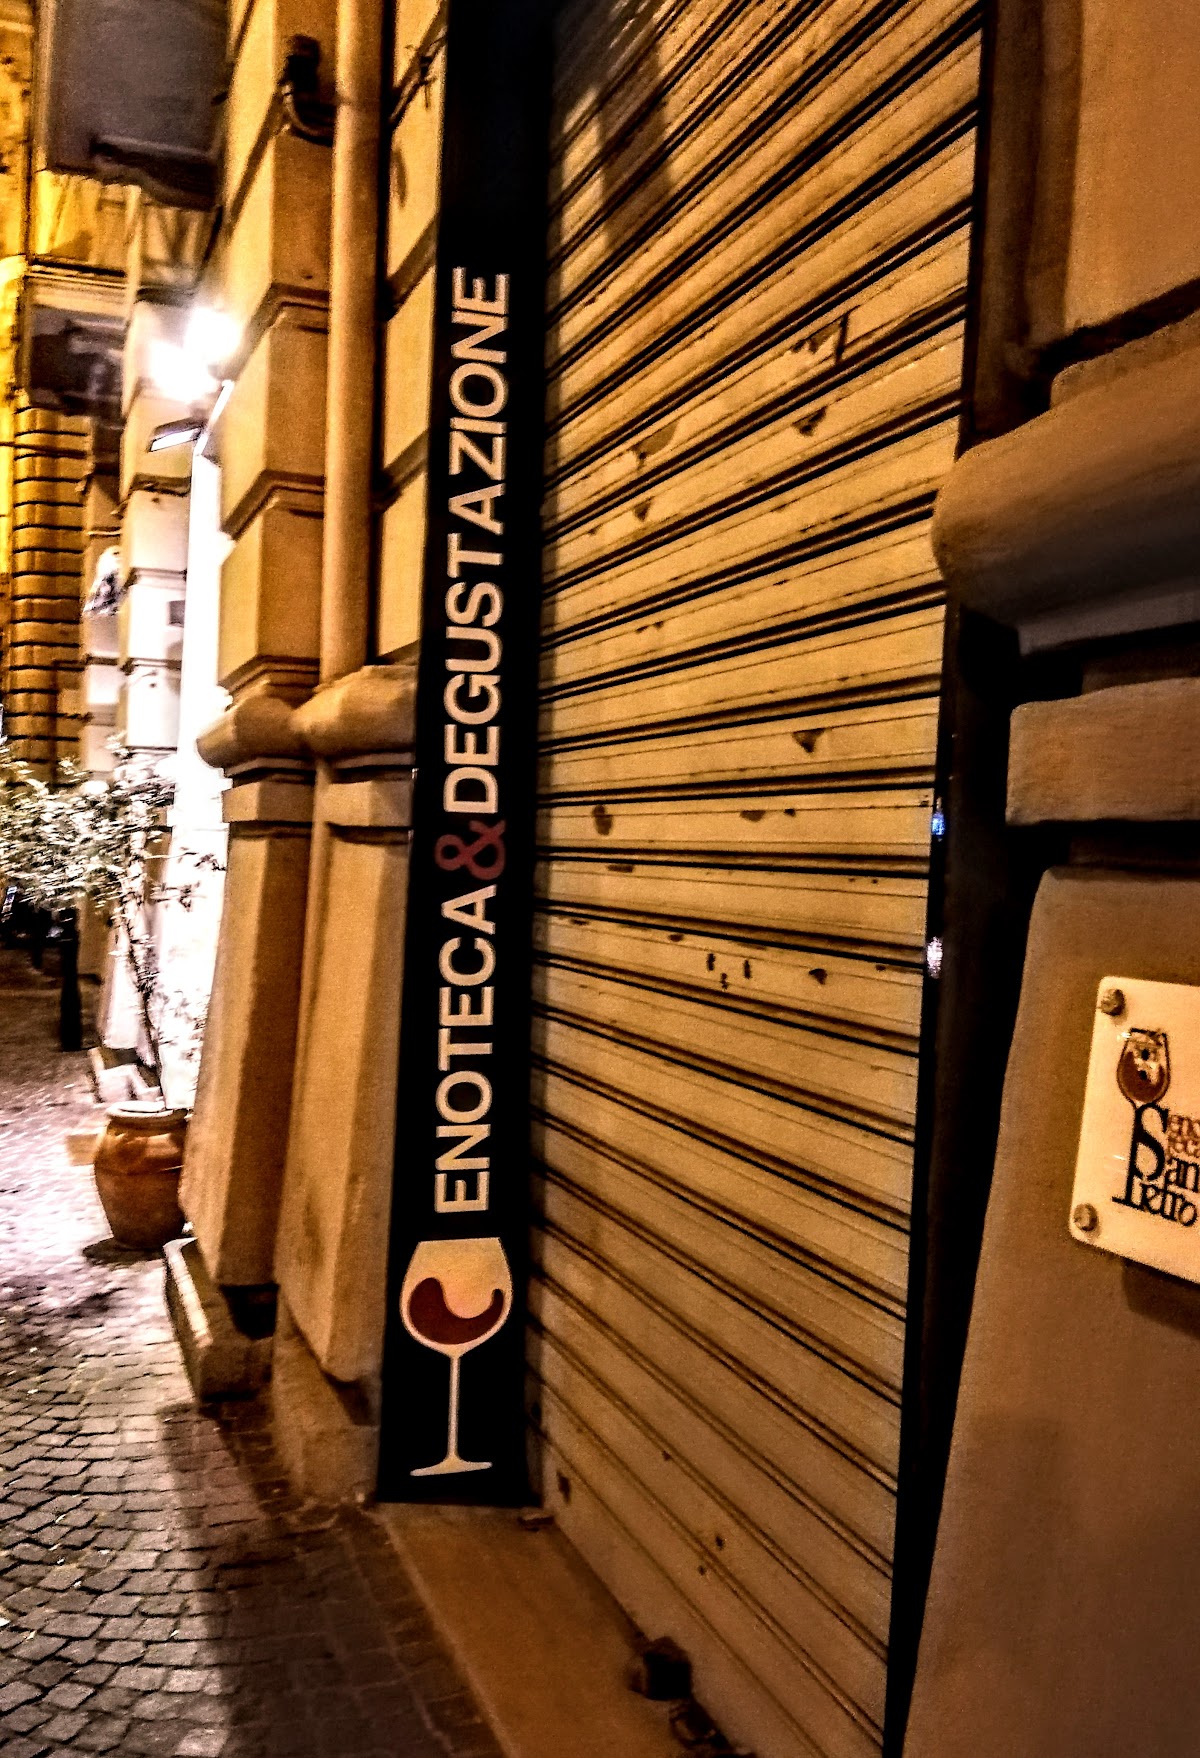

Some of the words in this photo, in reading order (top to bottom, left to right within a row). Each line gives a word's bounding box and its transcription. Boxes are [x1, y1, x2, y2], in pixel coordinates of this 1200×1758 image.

[443, 266, 510, 814] DEGUSTAZIONE
[434, 820, 506, 880] &
[434, 884, 497, 1214] ENOTECA
